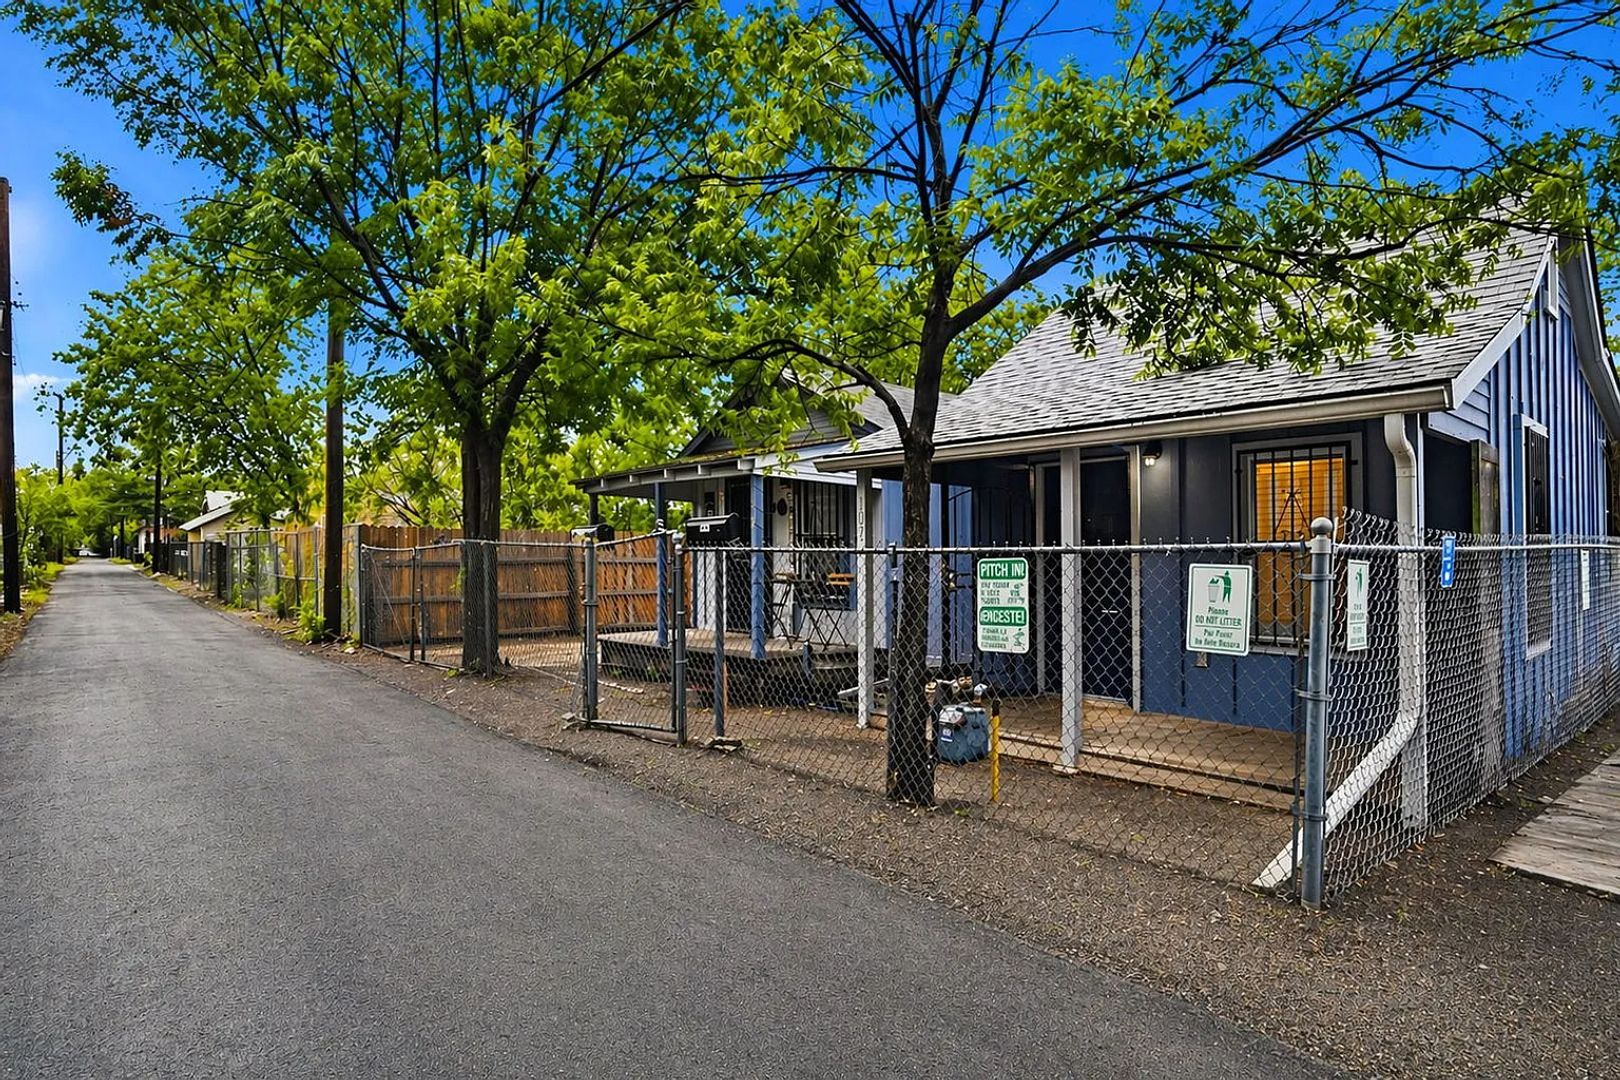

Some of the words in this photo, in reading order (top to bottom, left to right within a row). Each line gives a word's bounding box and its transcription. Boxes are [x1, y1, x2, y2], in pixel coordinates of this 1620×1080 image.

[980, 563, 1008, 578] PITCH
[1195, 615, 1204, 624] DO
[1205, 616, 1218, 625] NOT
[1220, 617, 1242, 627] LITTER
